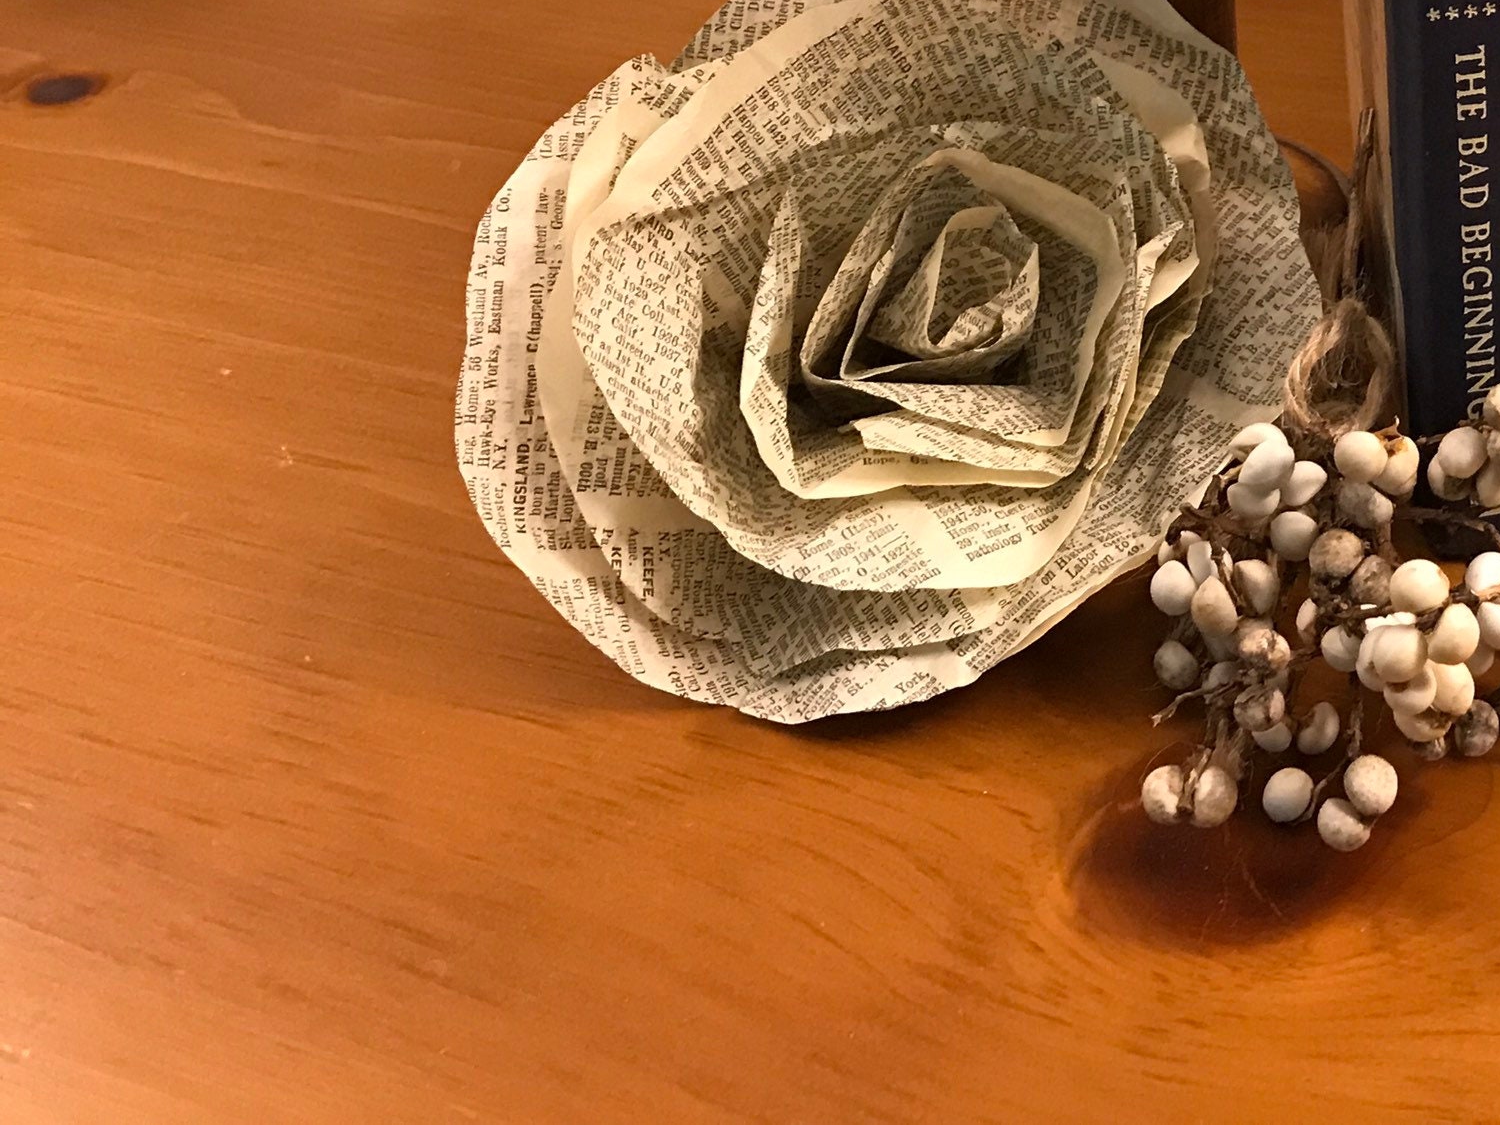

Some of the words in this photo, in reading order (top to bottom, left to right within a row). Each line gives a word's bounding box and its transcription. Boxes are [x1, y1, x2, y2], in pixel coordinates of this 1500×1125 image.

[1455, 44, 1486, 121] THE
[731, 103, 766, 148] Happen
[1458, 134, 1489, 209] BAD
[491, 224, 509, 266] Kodak
[531, 224, 550, 265] patent
[487, 279, 506, 334] Eastman
[475, 397, 498, 467] Hawk-Eye
[965, 531, 1024, 562] pathology
